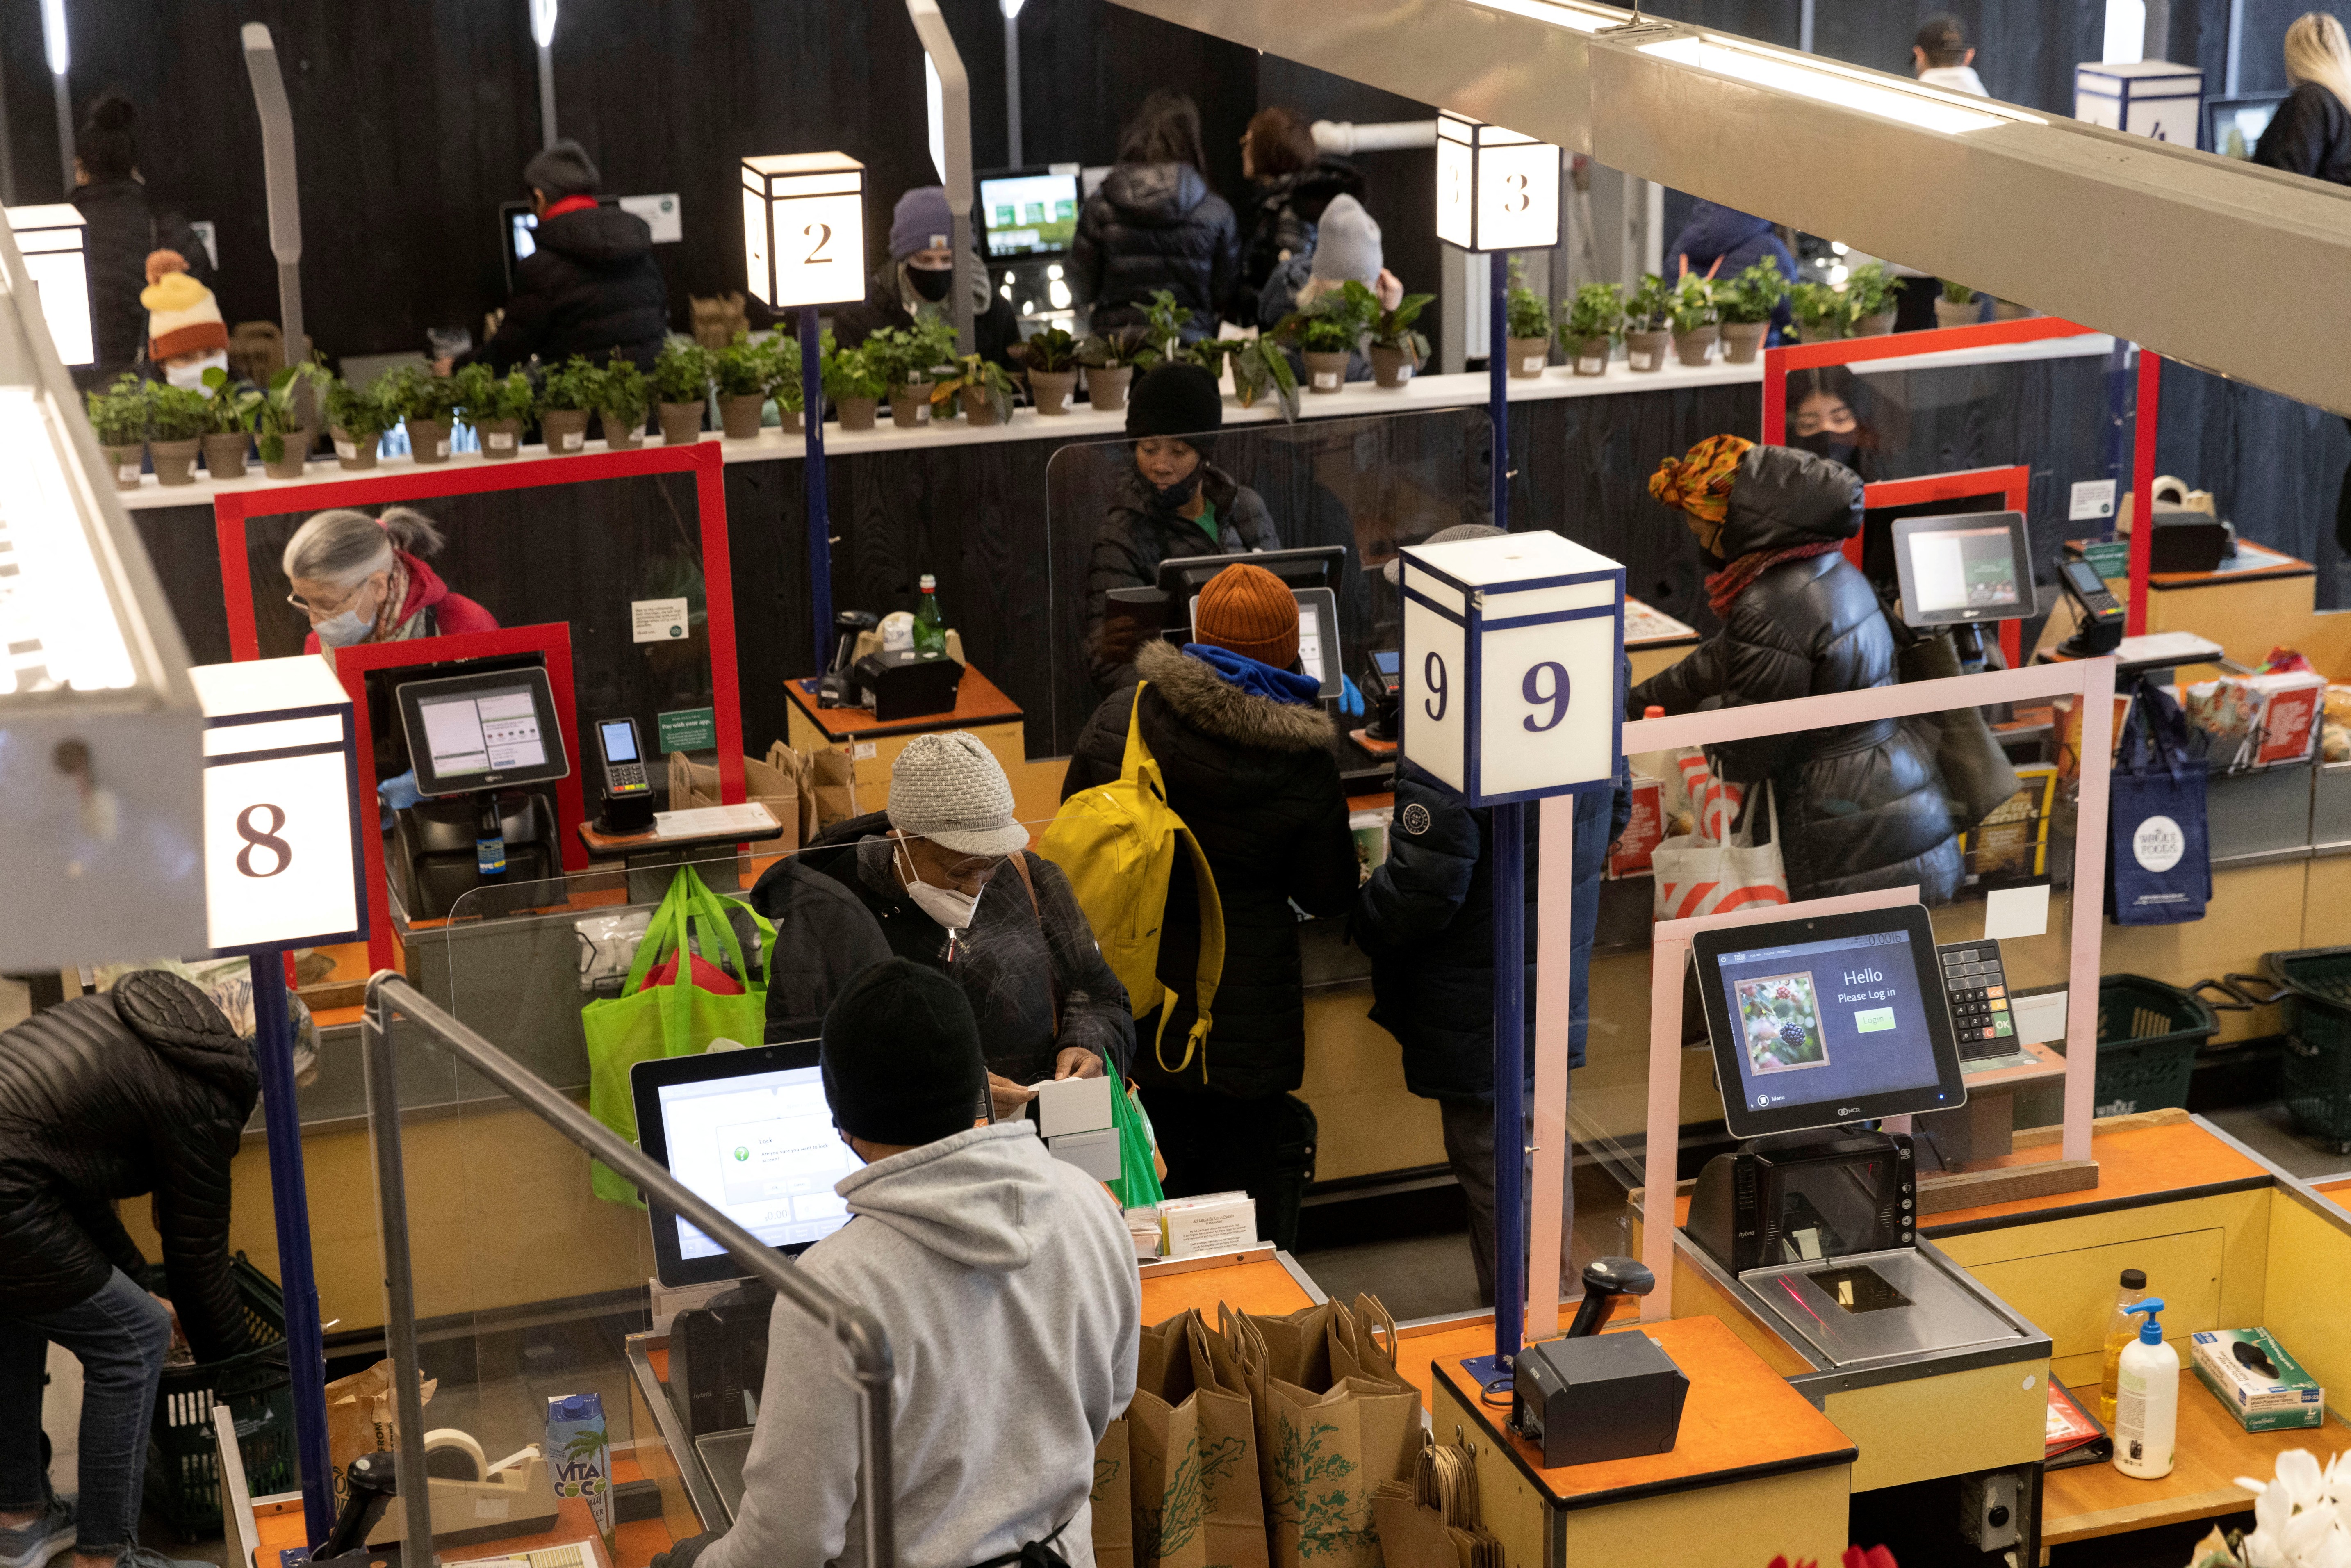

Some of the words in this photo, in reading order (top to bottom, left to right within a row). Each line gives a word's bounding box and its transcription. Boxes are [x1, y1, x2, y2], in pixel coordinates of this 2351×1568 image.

[1505, 174, 1529, 212] 3
[804, 223, 832, 264] 2
[1424, 651, 1448, 722] 9
[1522, 661, 1571, 732] 9
[235, 803, 292, 877] 8
[2140, 833, 2178, 843] WHOLE
[2141, 844, 2177, 855] FOODS
[1868, 933, 1901, 946] 0.00lb
[1844, 968, 1883, 985] Hello
[1838, 991, 1867, 1003] Please
[1868, 989, 1886, 1001] Log
[1887, 988, 1896, 996] in
[1863, 1015, 1884, 1025] Login
[1996, 1020, 2010, 1029] OK
[1530, 1367, 1540, 1380] EPSON
[2308, 1406, 2316, 1415] L
[374, 1422, 385, 1452] FROM
[555, 1461, 601, 1482] VITA
[554, 1477, 606, 1497] COCO
